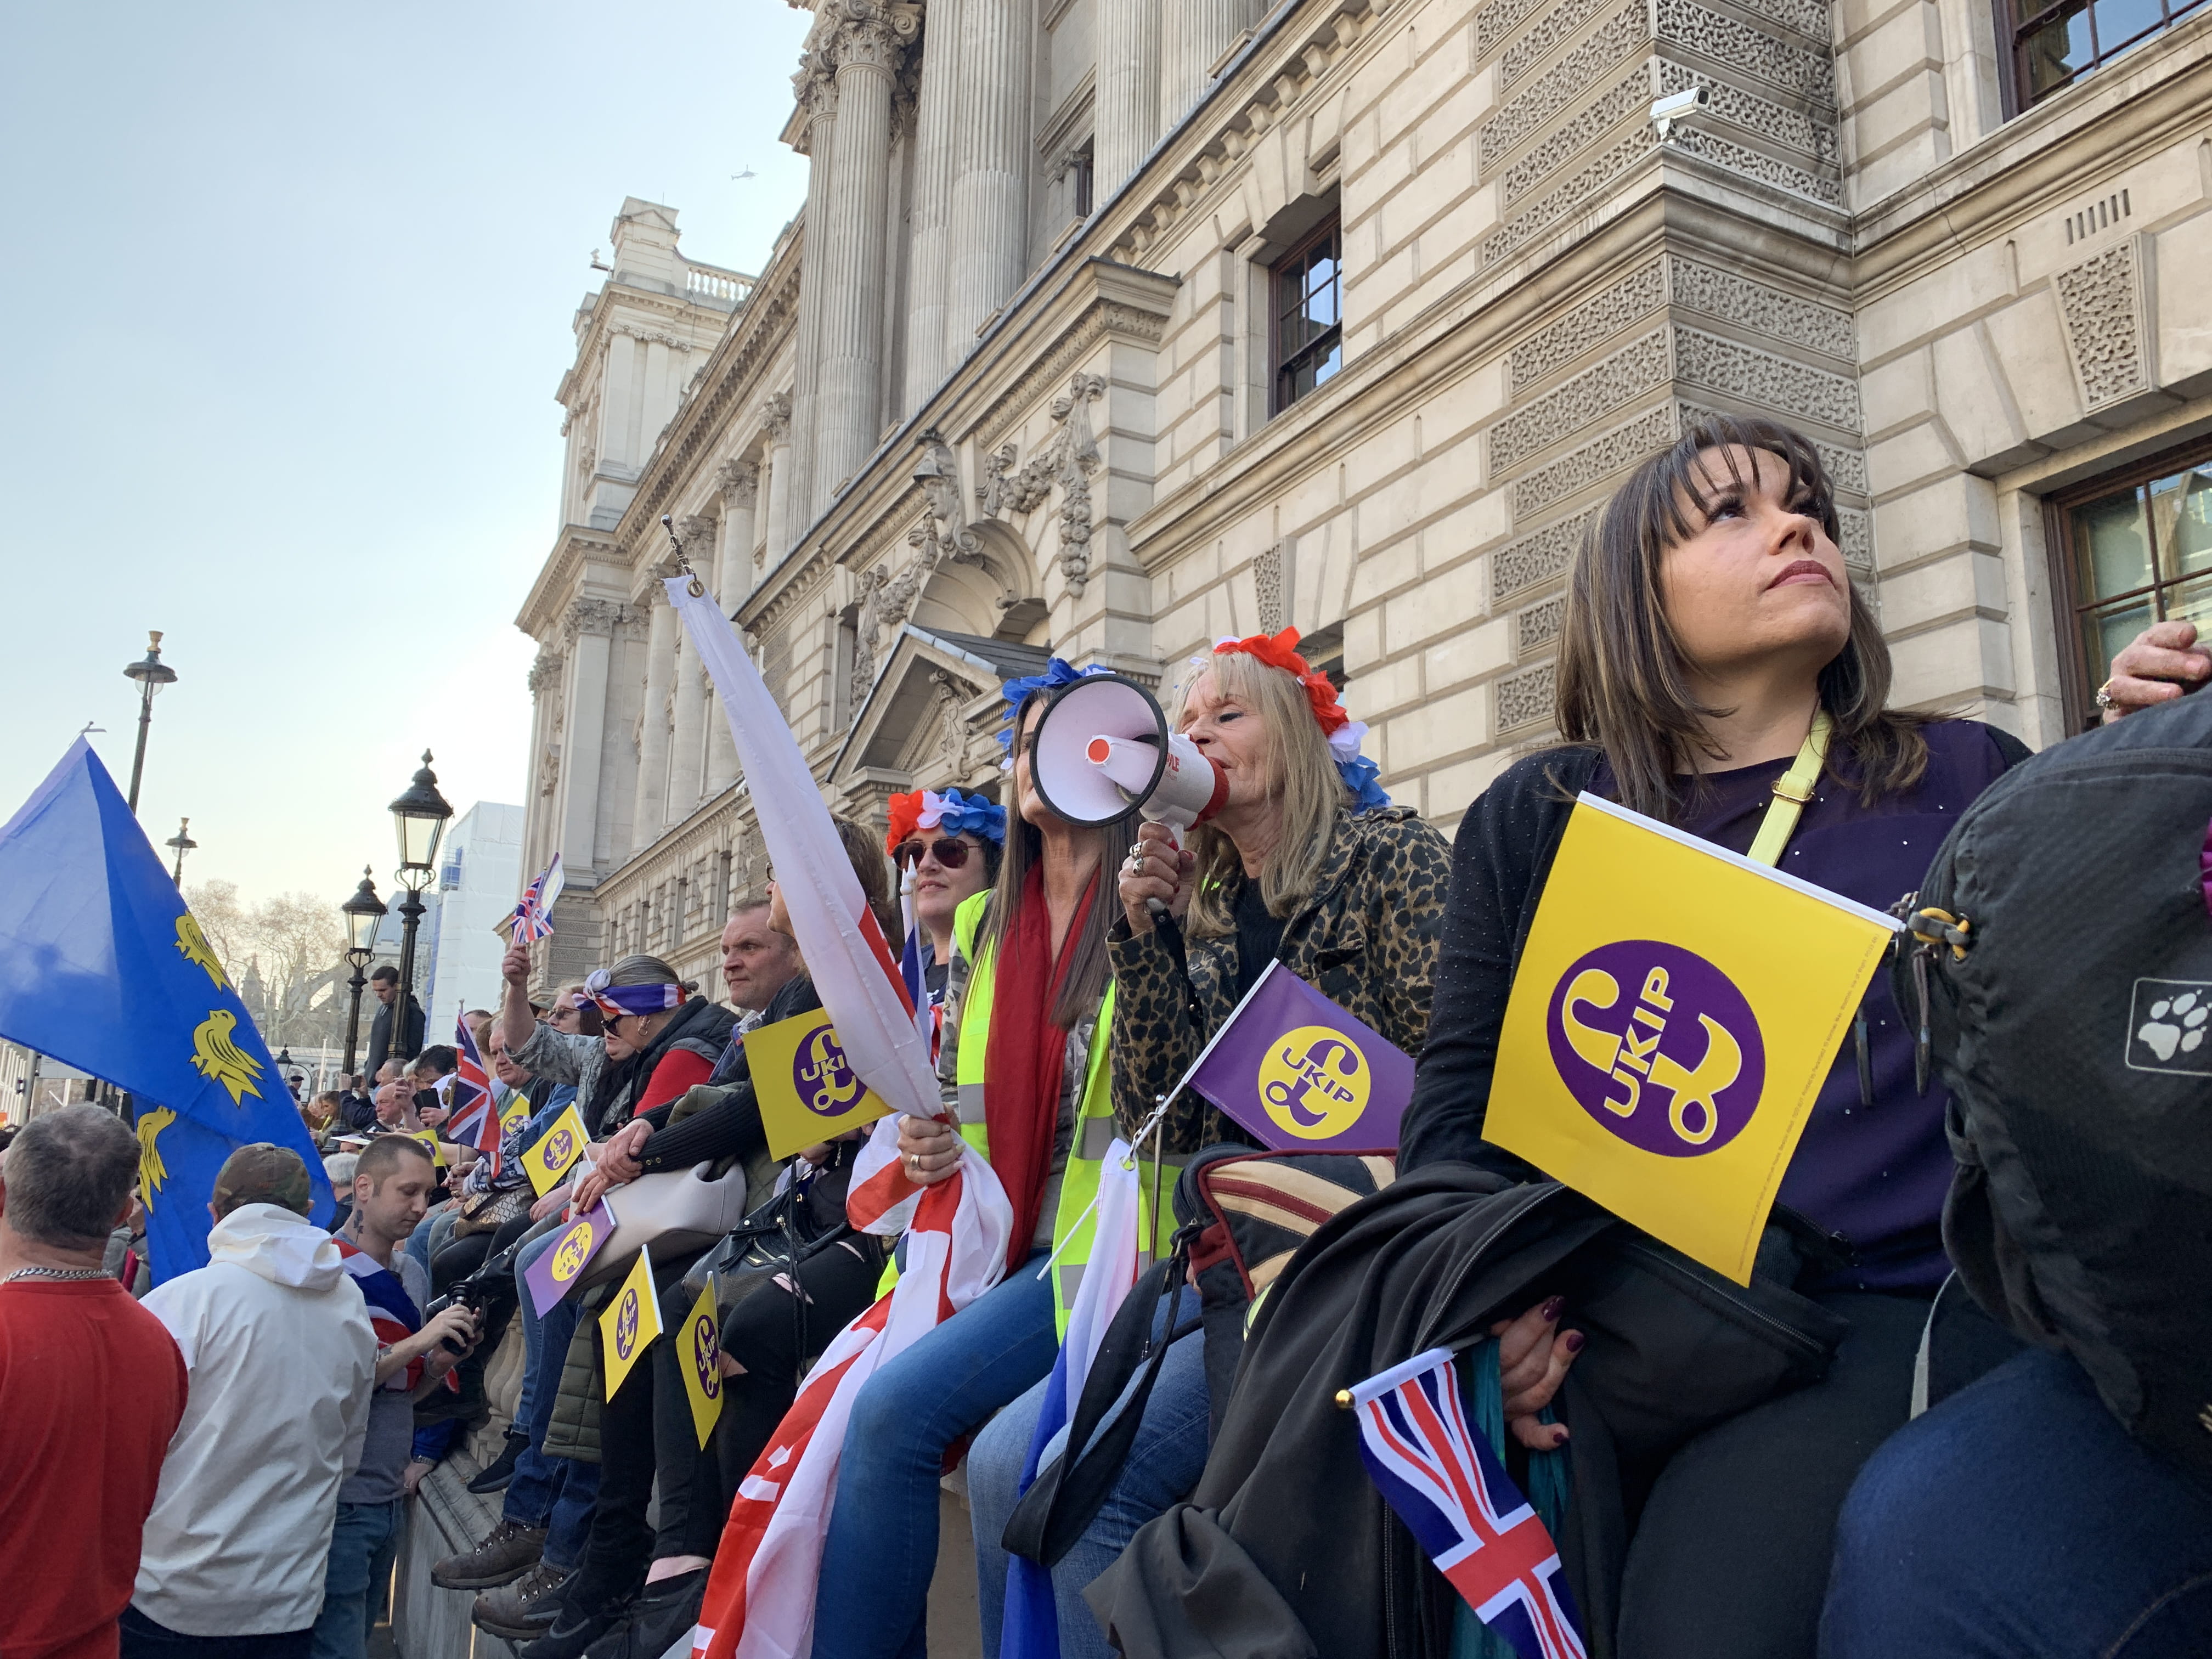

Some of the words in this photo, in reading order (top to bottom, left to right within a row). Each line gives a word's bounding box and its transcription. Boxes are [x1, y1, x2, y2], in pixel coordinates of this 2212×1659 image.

[1167, 753, 1180, 772] YLE
[1604, 966, 1674, 1118] UKIP
[801, 1055, 845, 1081] UKI
[1282, 1047, 1355, 1103] UKIP
[546, 1136, 568, 1161] UKIP
[559, 1234, 588, 1273] UKIP
[619, 1303, 636, 1338] UKIP
[699, 1334, 715, 1372] UKIP
